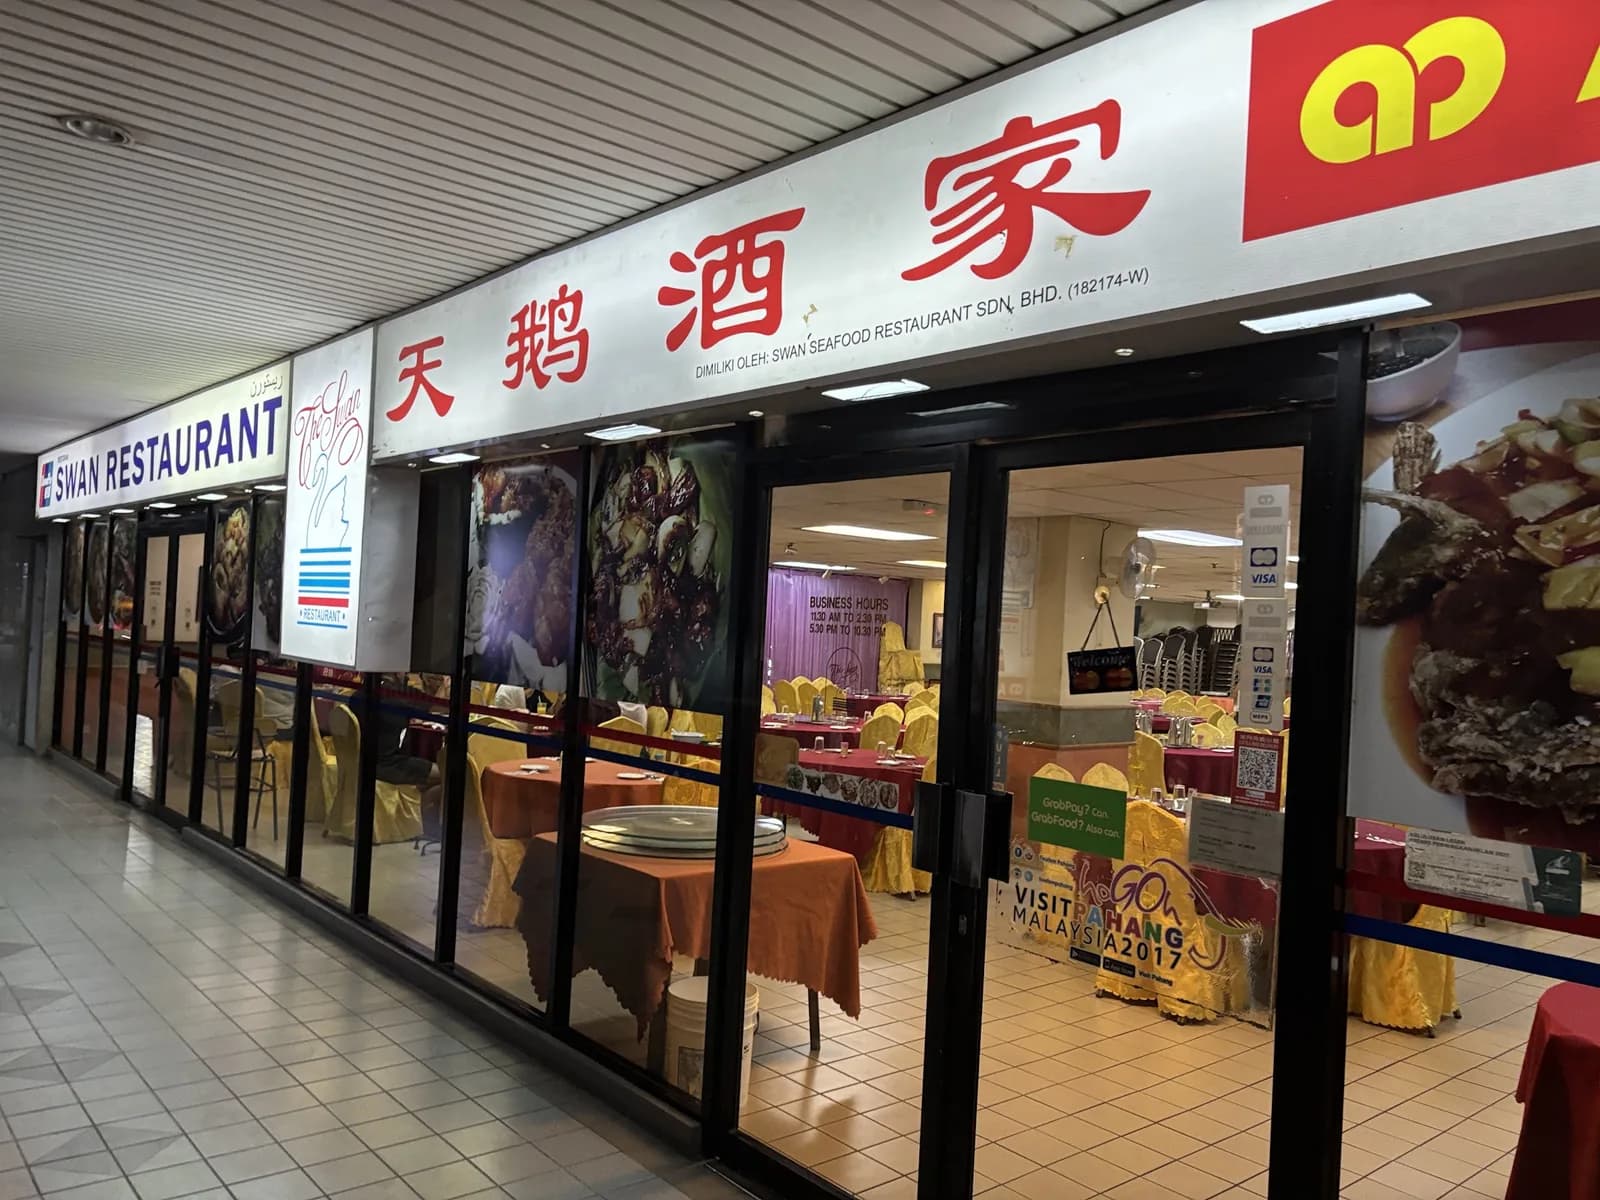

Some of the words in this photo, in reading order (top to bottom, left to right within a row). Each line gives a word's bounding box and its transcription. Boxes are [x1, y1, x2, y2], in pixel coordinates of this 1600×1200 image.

[386, 98, 1151, 421] 天鹅酒家
[695, 361, 735, 379] DIMILIKI
[737, 352, 770, 370] OLEH:
[772, 342, 806, 362] SWAN
[809, 327, 871, 354] SEAFOOD
[874, 304, 973, 341] RESTAURANT
[976, 295, 1015, 317] SDN.
[1020, 285, 1062, 307] BHD.
[1067, 267, 1150, 300] (182174-W)
[56, 455, 99, 502] SWAN
[106, 395, 283, 491] RESTAURANT
[1252, 574, 1277, 584] VISA
[810, 596, 853, 609] BUSINESS
[856, 598, 889, 610] HOURS
[303, 607, 341, 622] RESTAURANT
[829, 612, 840, 621] AM
[844, 613, 854, 623] TO
[826, 625, 838, 635] PM
[840, 625, 850, 636] TO
[1254, 666, 1273, 674] VISA
[1042, 797, 1090, 817] GrabPay?
[1031, 811, 1084, 831] GrabFood?
[1086, 823, 1103, 834] Also
[1015, 882, 1072, 917] VISIT
[1073, 903, 1184, 949] PAHANG
